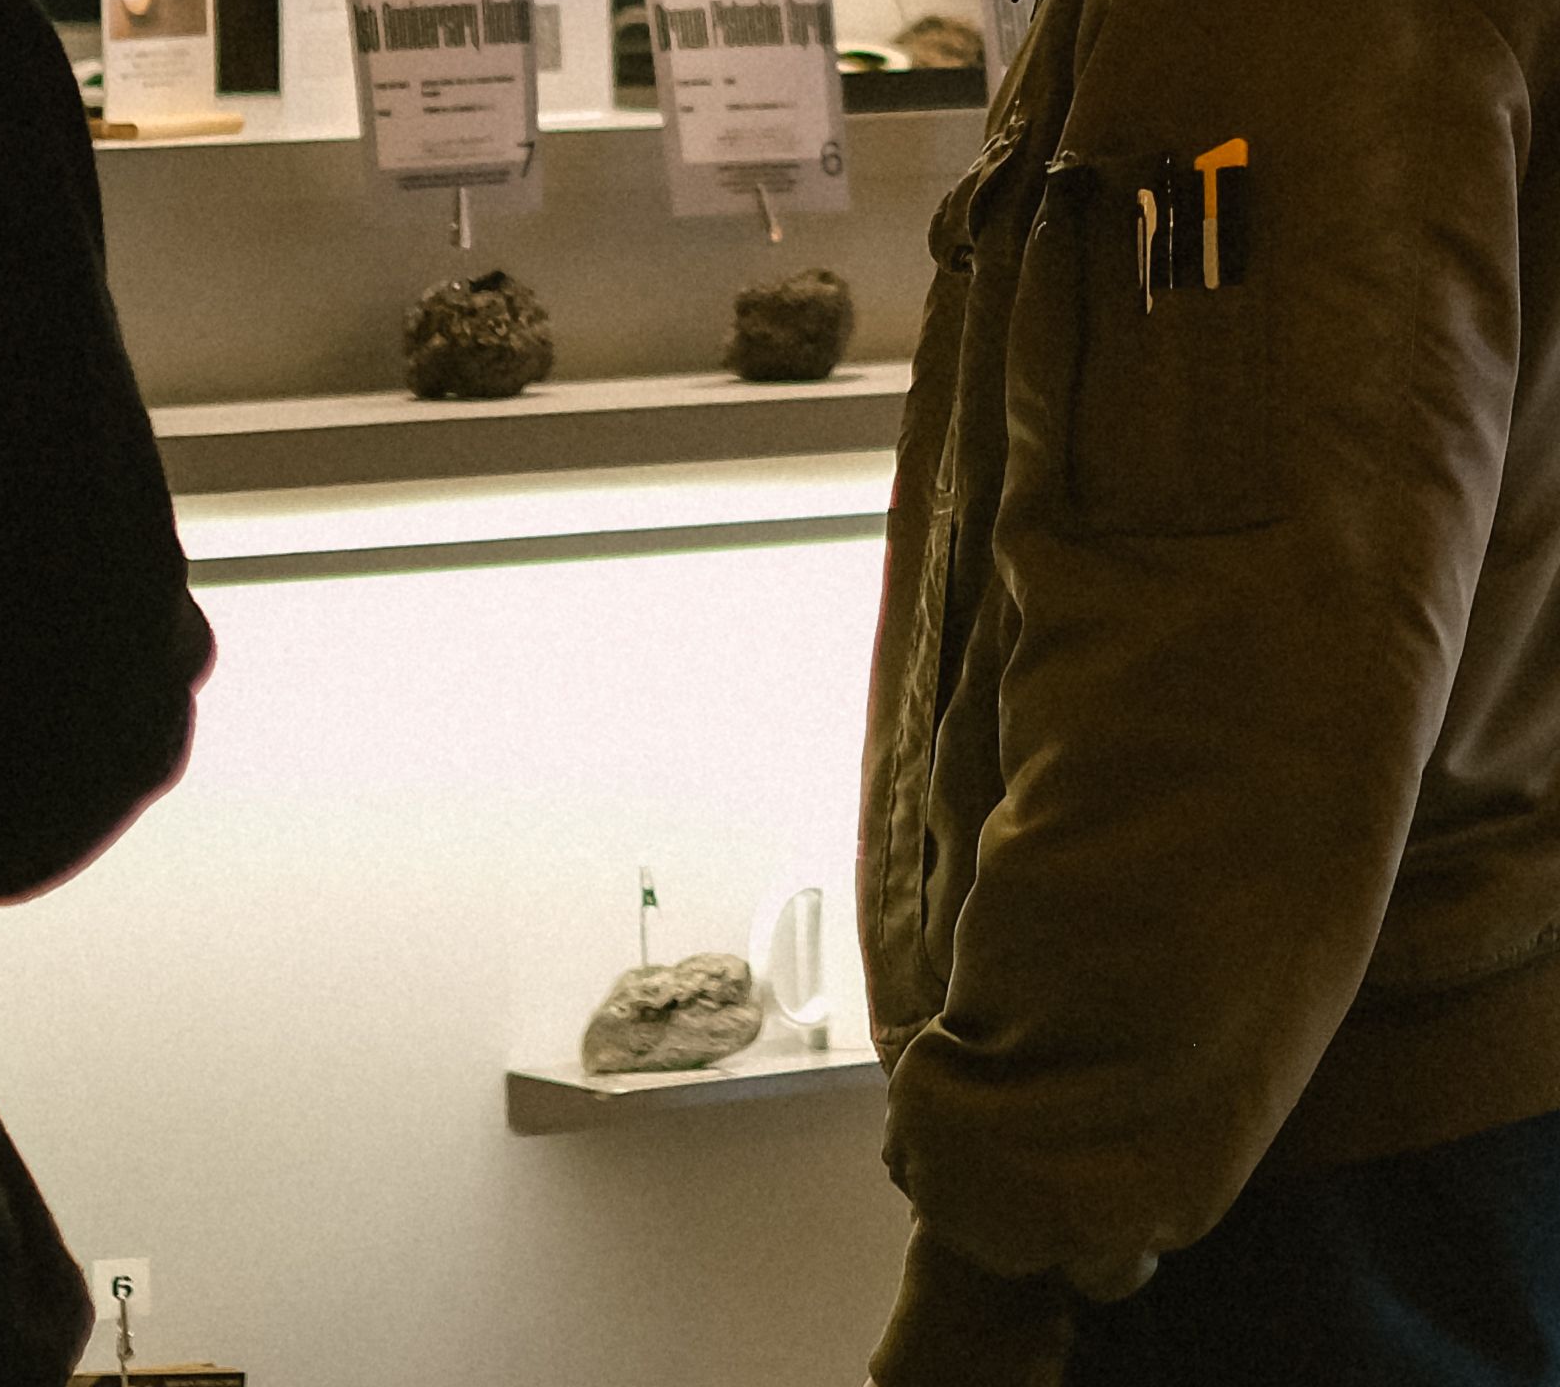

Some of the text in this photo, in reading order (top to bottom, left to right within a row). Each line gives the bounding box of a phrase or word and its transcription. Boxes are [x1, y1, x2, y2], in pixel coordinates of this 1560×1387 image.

[516, 140, 535, 178] 7
[821, 140, 842, 177] 6
[112, 1276, 133, 1301] 6
